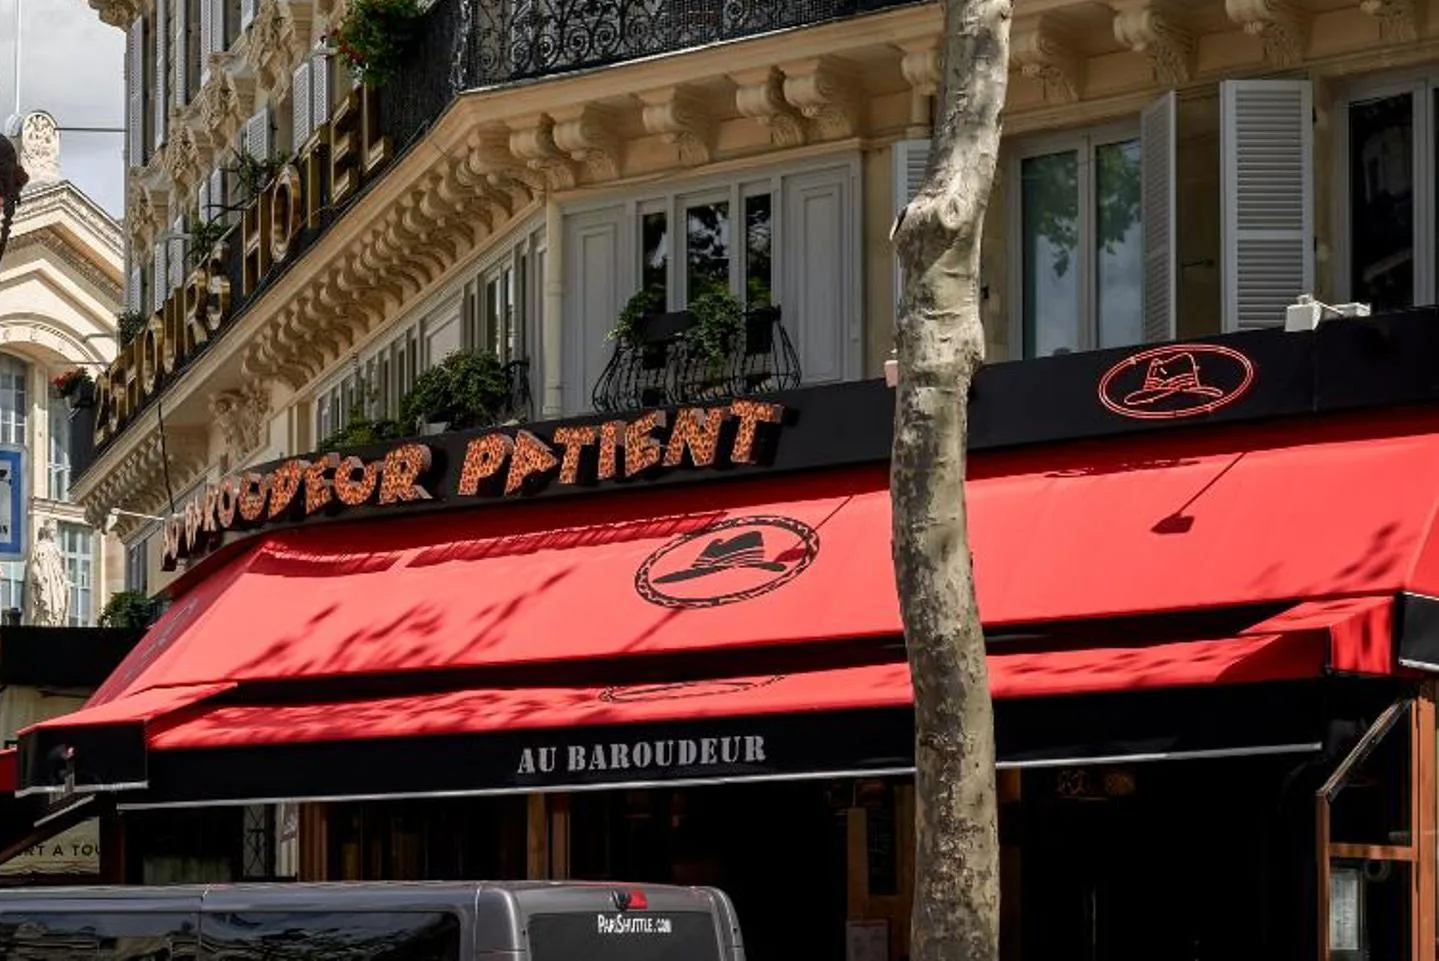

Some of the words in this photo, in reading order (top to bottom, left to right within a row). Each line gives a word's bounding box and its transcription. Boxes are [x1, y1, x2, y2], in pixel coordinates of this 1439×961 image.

[242, 82, 385, 296] HOTEL
[457, 399, 785, 496] PATIENT
[517, 747, 557, 774] AU
[567, 735, 766, 771] BAROUDEUR
[53, 844, 64, 857] A
